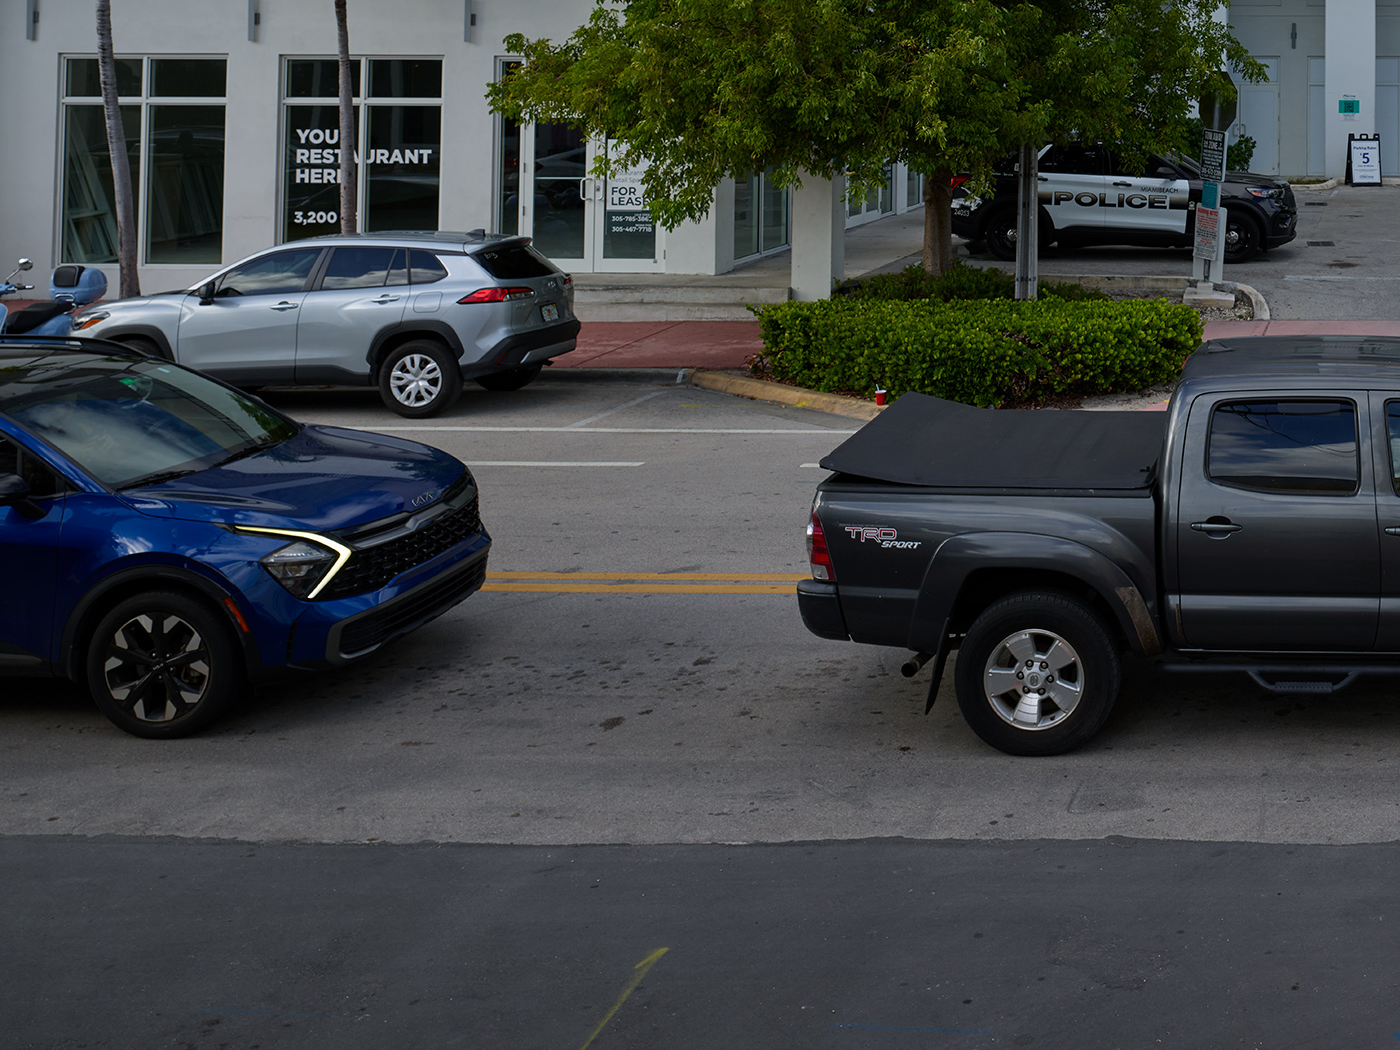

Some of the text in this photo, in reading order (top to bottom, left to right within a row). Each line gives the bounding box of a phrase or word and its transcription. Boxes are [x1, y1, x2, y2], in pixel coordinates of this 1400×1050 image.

[296, 129, 339, 144] YOU
[296, 149, 432, 164] RESTURANT
[611, 186, 636, 196] FOR
[1054, 191, 1168, 210] POLICE
[294, 211, 337, 225] 3,200
[845, 526, 897, 543] TRD
[881, 540, 922, 550] SPORT
